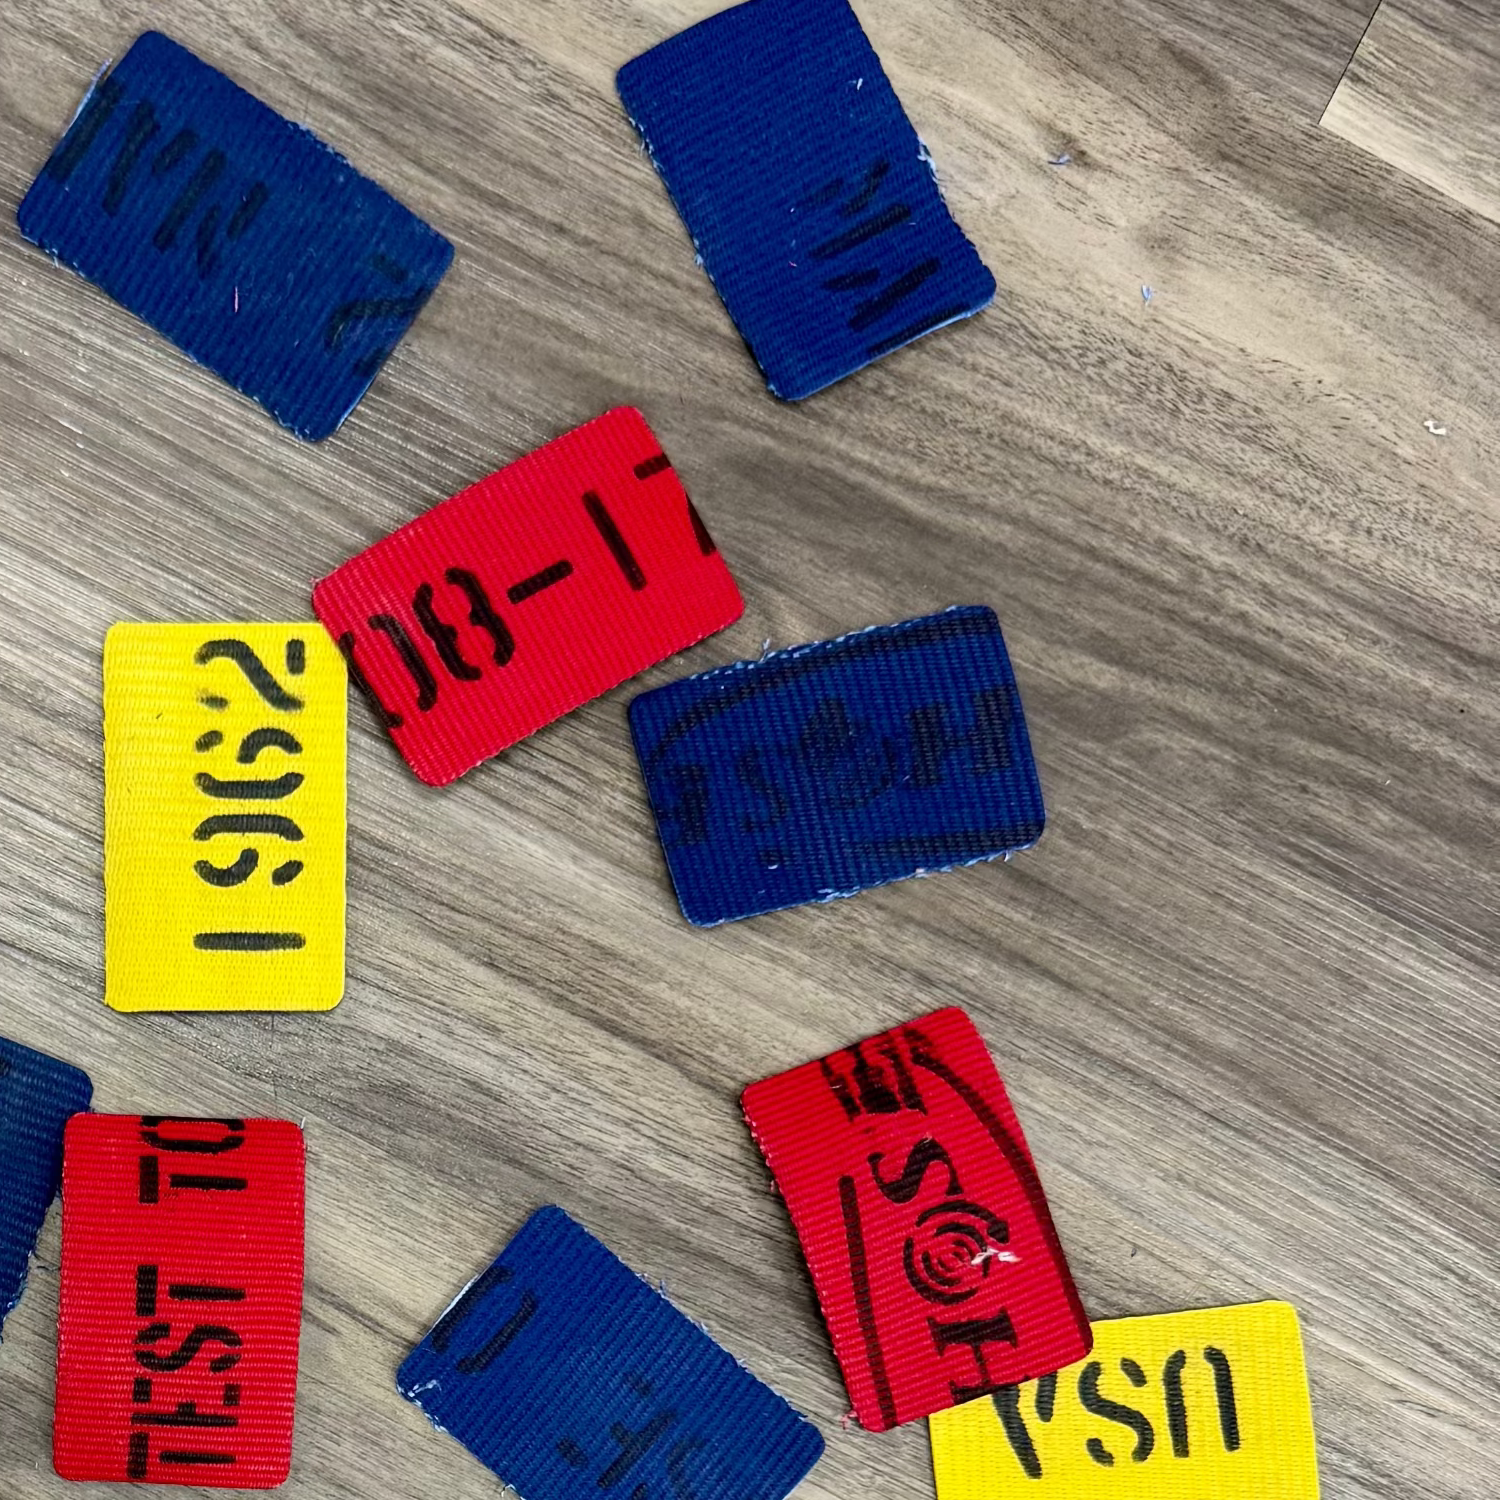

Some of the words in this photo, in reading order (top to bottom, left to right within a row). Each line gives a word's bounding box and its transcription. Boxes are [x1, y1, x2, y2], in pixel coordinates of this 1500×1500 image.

[193, 638, 306, 951] 1962
[137, 1115, 248, 1204] TO
[126, 1264, 247, 1479] TEST
[991, 1345, 1241, 1480] USA
